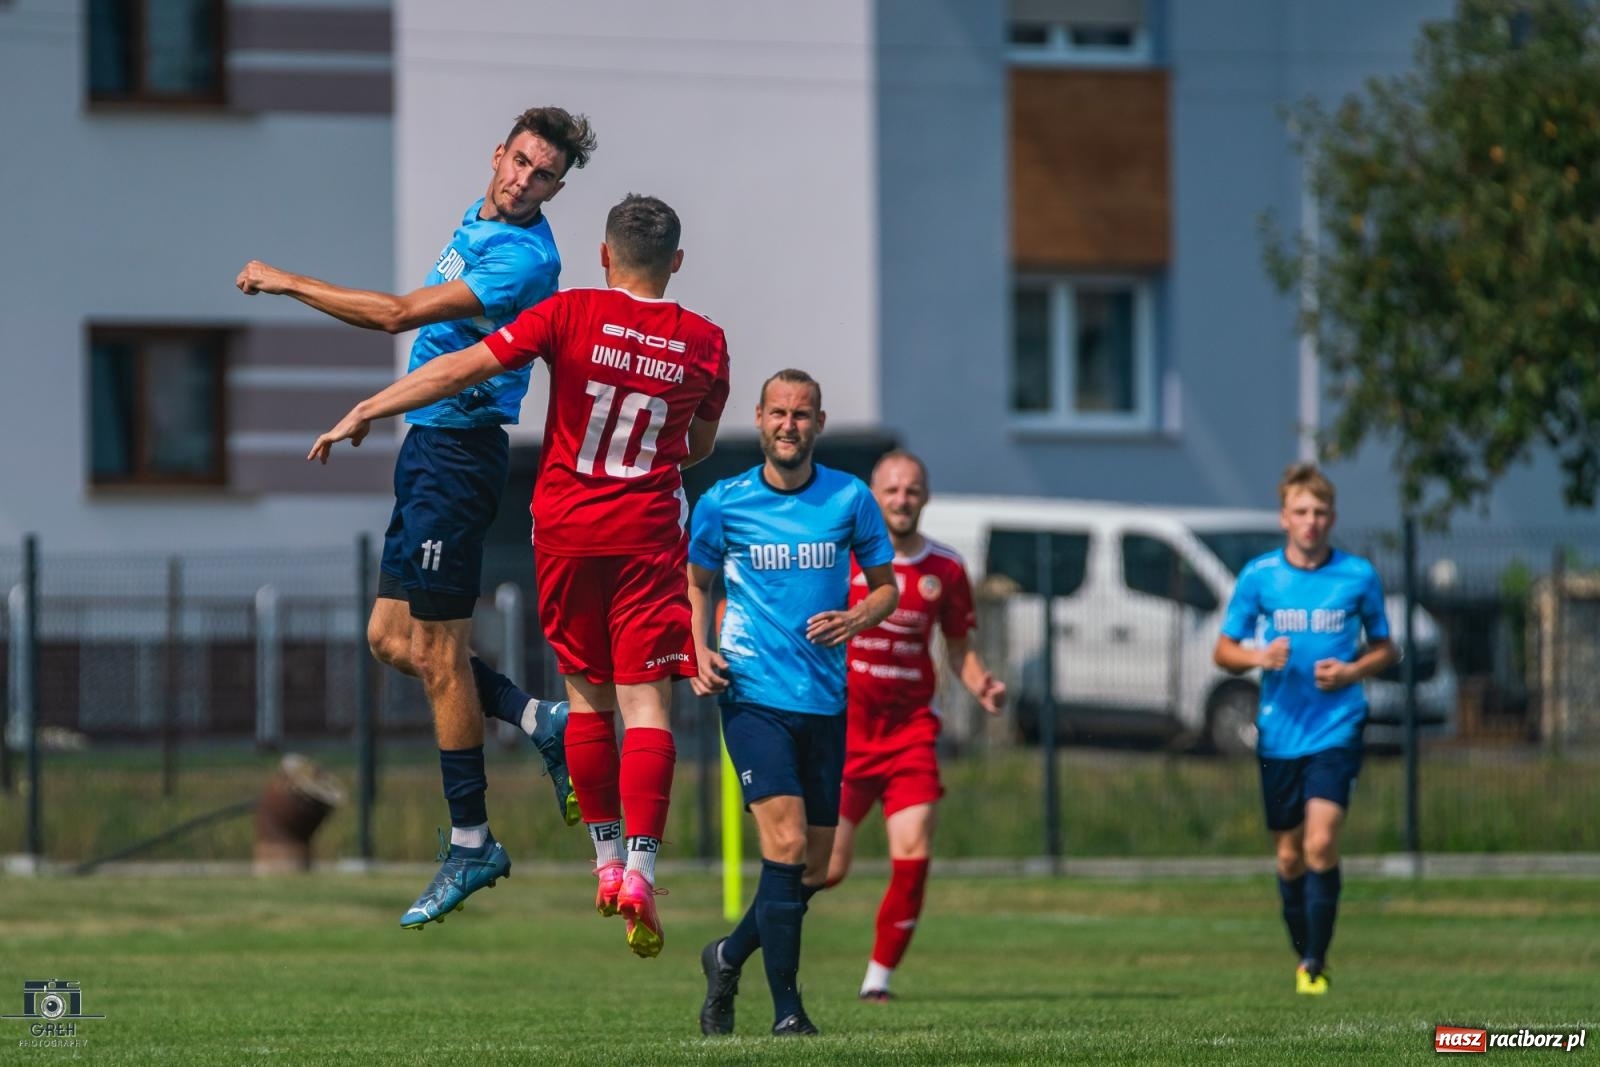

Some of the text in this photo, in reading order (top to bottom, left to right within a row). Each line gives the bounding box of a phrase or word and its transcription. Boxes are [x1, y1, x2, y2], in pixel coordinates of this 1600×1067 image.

[602, 323, 687, 353] GROS
[591, 344, 684, 384] UNIA TURZA
[576, 379, 669, 479] 10
[421, 539, 443, 571] 11
[750, 542, 836, 570] DAR-BUD
[656, 653, 690, 666] PATRICK
